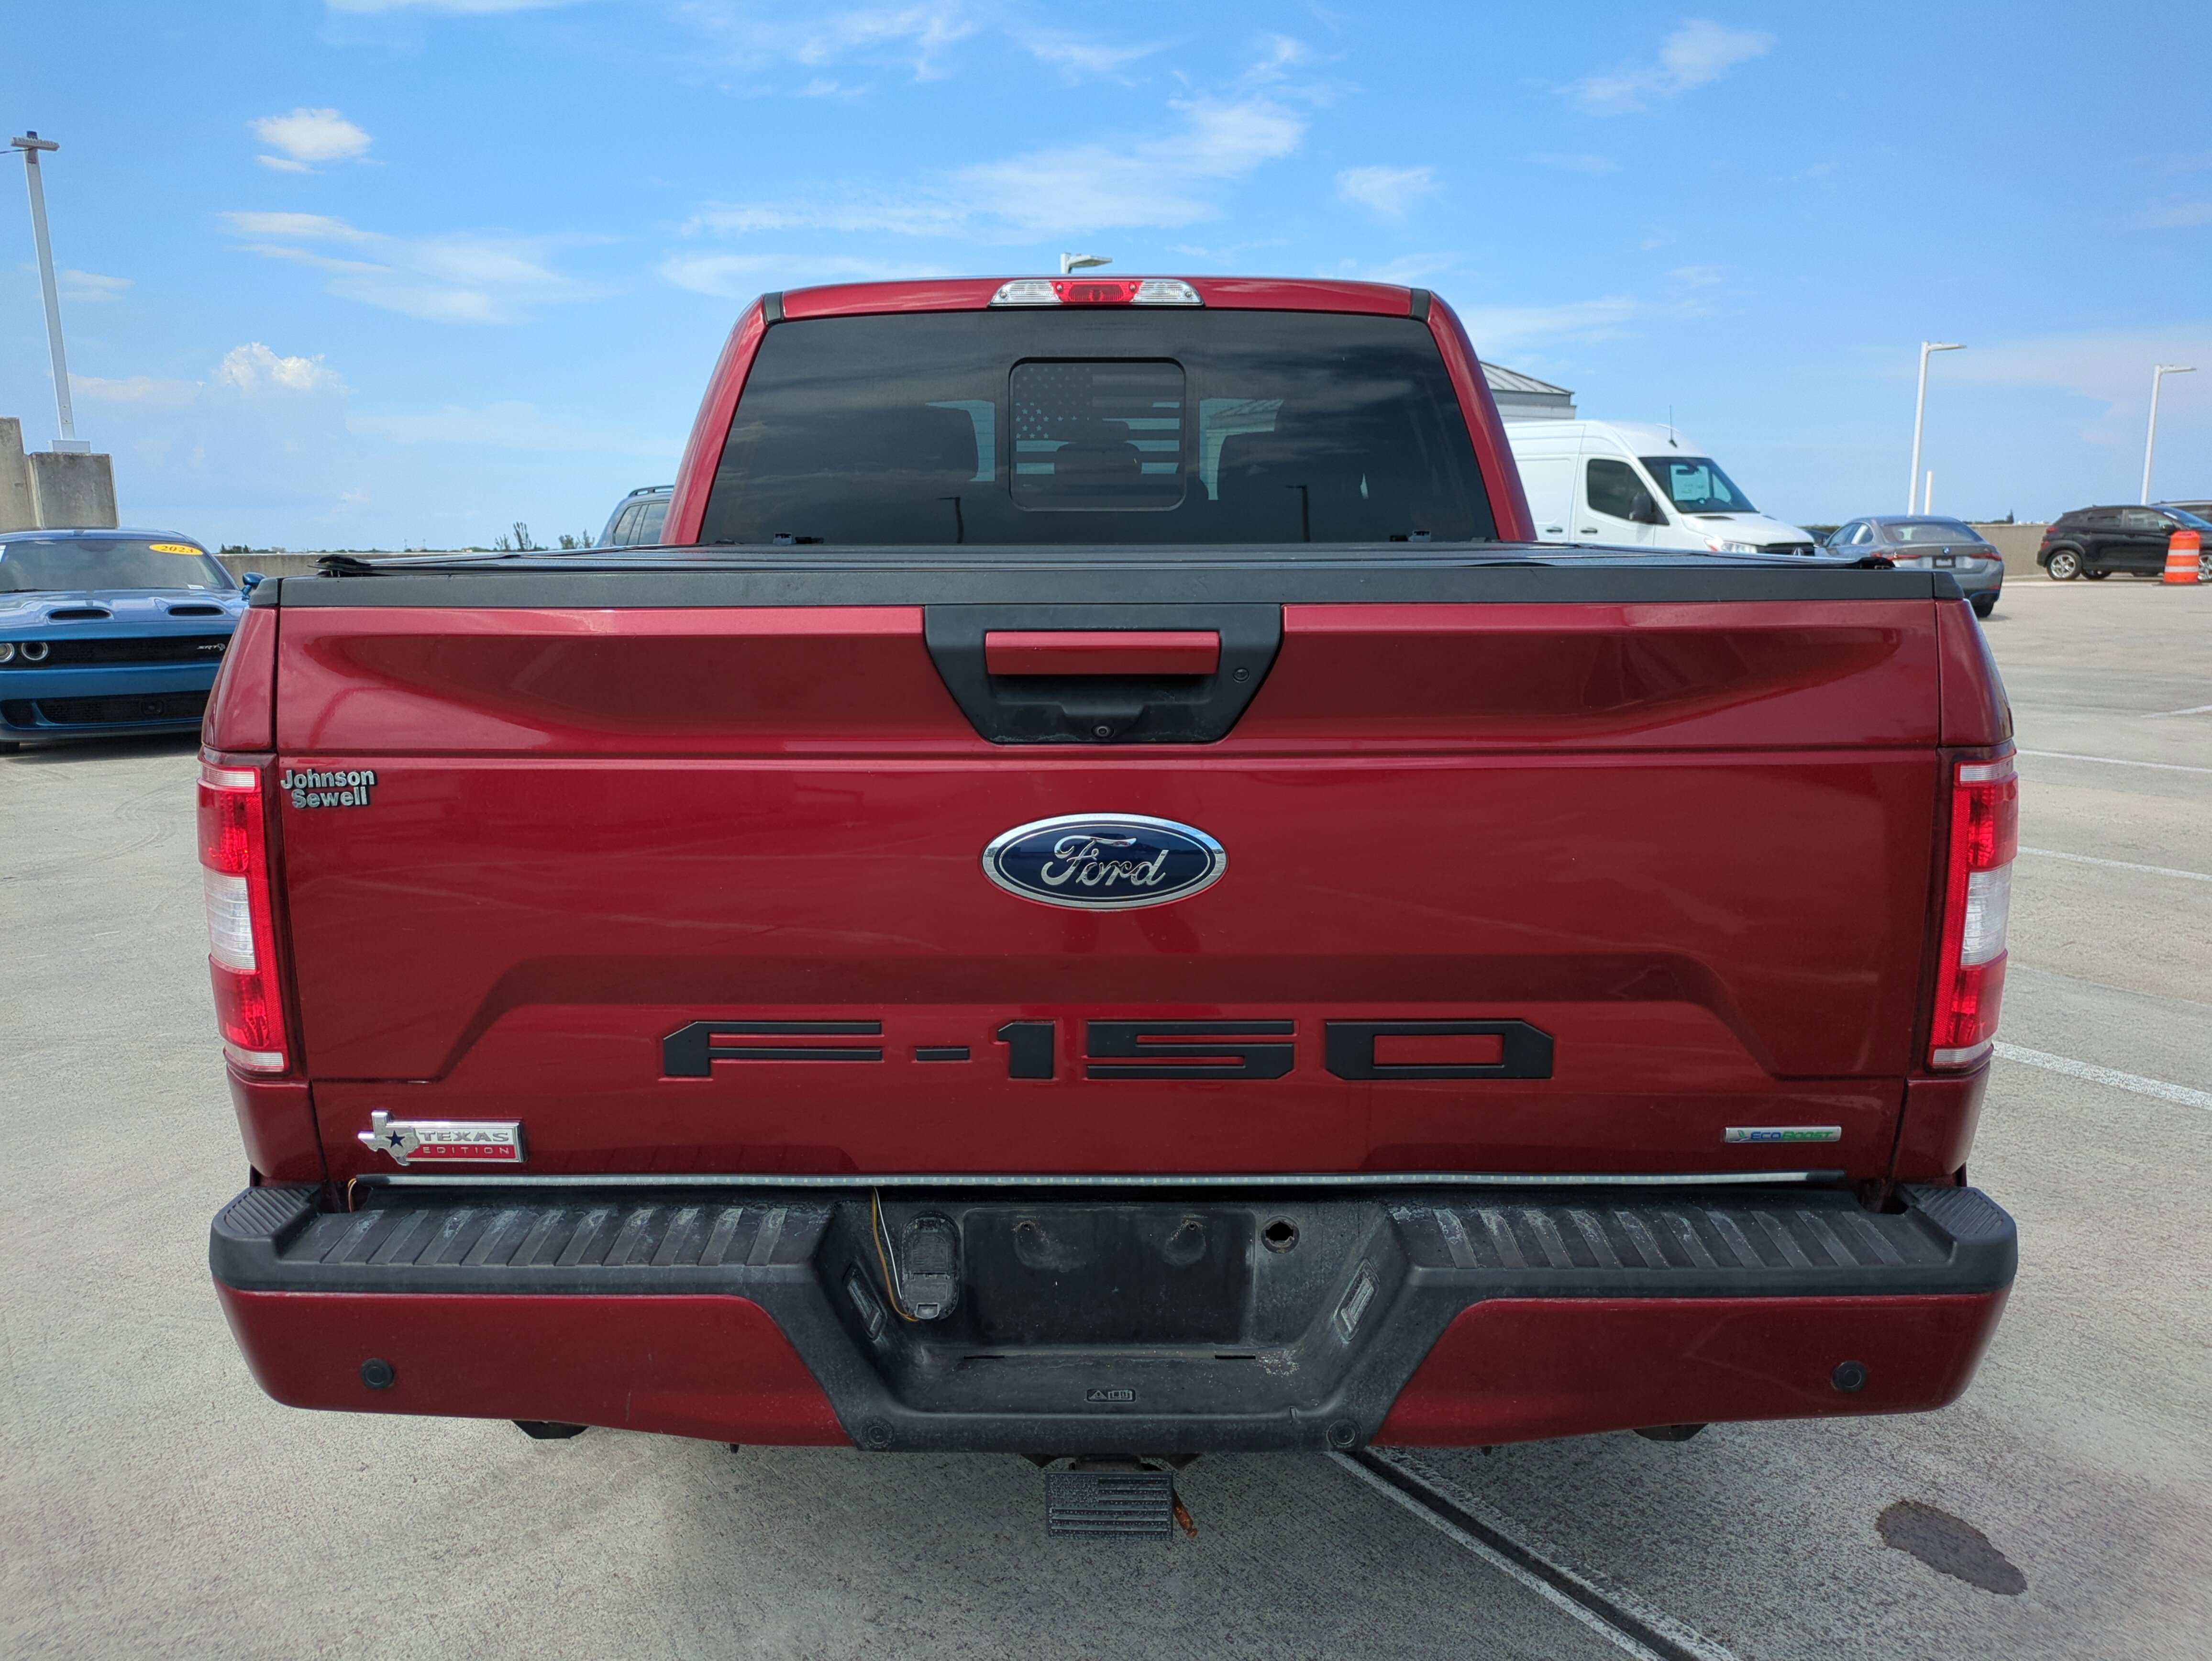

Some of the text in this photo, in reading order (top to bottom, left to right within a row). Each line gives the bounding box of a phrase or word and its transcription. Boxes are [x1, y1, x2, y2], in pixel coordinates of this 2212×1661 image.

[280, 769, 376, 789] Johnson
[291, 786, 368, 808] Sewell
[1040, 834, 1169, 886] Ford
[663, 1019, 1554, 1079] F-150
[419, 1130, 509, 1142] TEXAS
[1750, 1131, 1834, 1140] ECOBOOST
